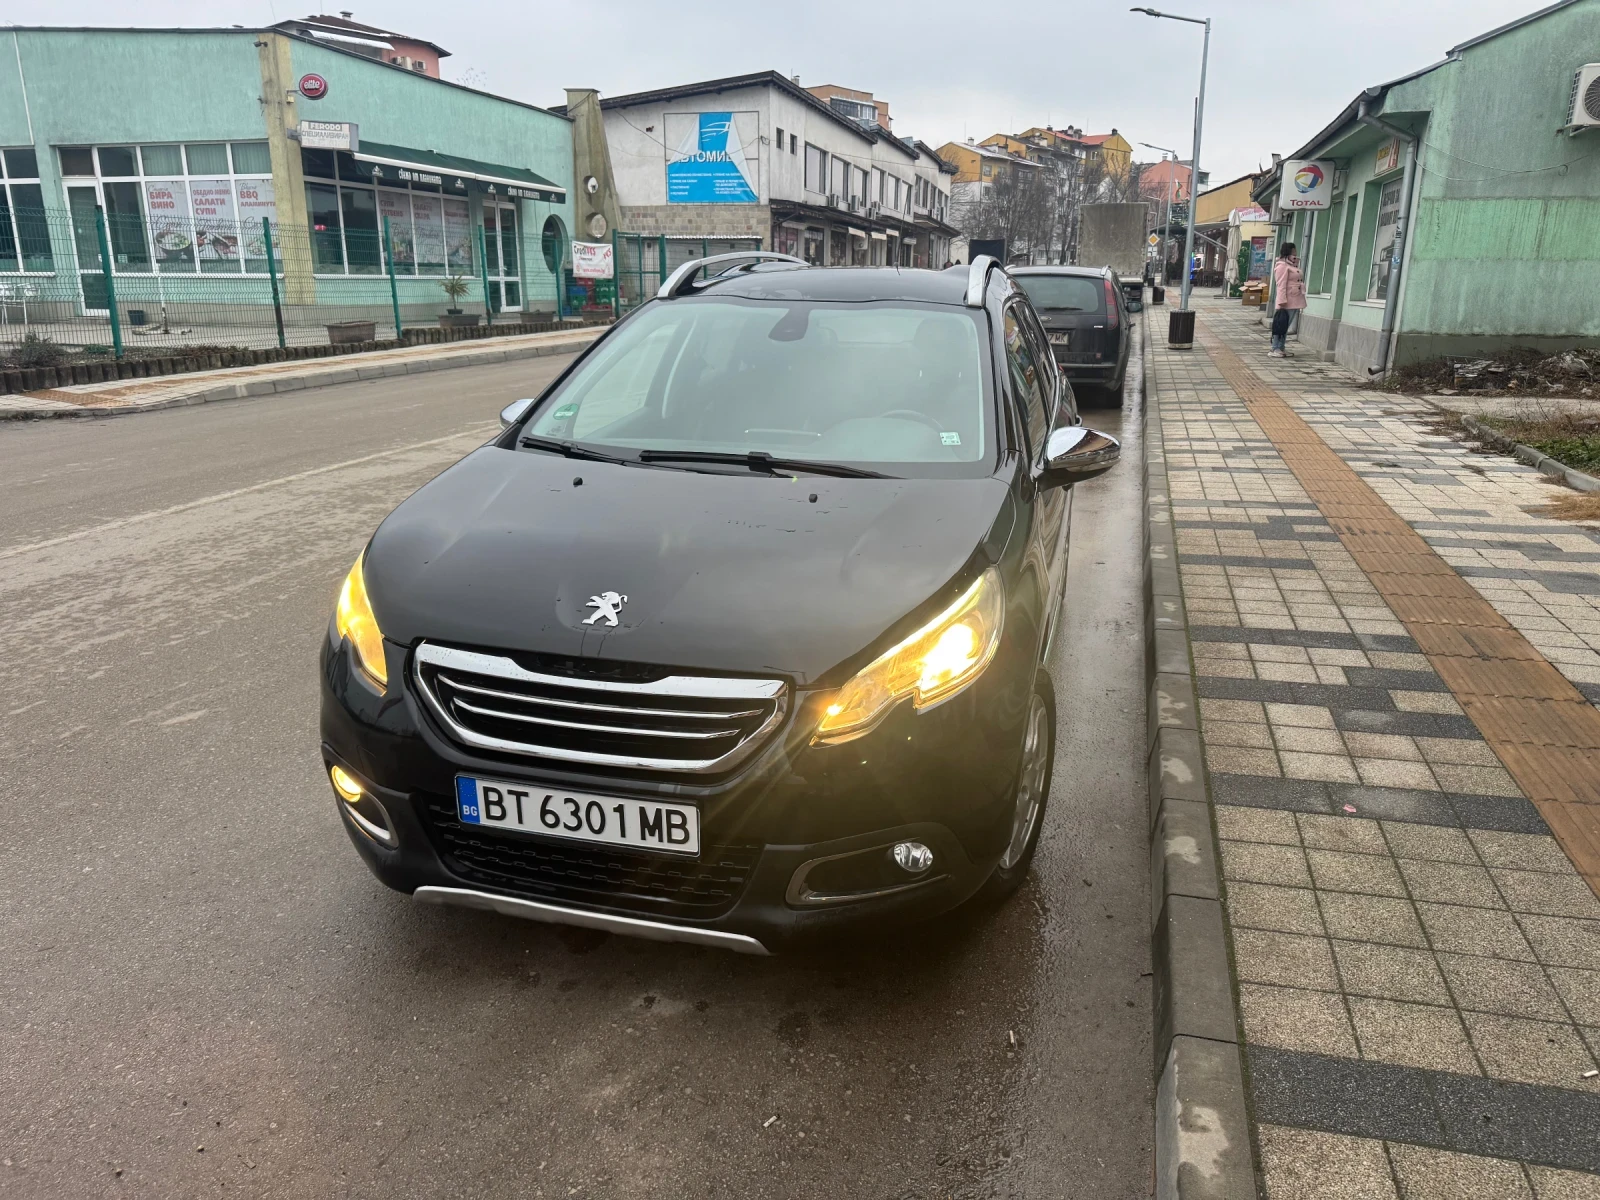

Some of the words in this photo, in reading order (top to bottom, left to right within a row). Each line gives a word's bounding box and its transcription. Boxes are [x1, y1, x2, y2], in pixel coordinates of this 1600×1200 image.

[310, 123, 341, 131] FERODO
[150, 191, 173, 200] БИРА
[239, 190, 258, 200] BBQ
[151, 201, 175, 210] ВИНО
[194, 198, 226, 206] САЛАТИ
[1290, 199, 1323, 207] TOTAL
[195, 207, 217, 216] СУПИ
[463, 805, 478, 817] BG
[482, 786, 530, 825] BT
[539, 794, 627, 839] 6301
[638, 805, 690, 845] MB
